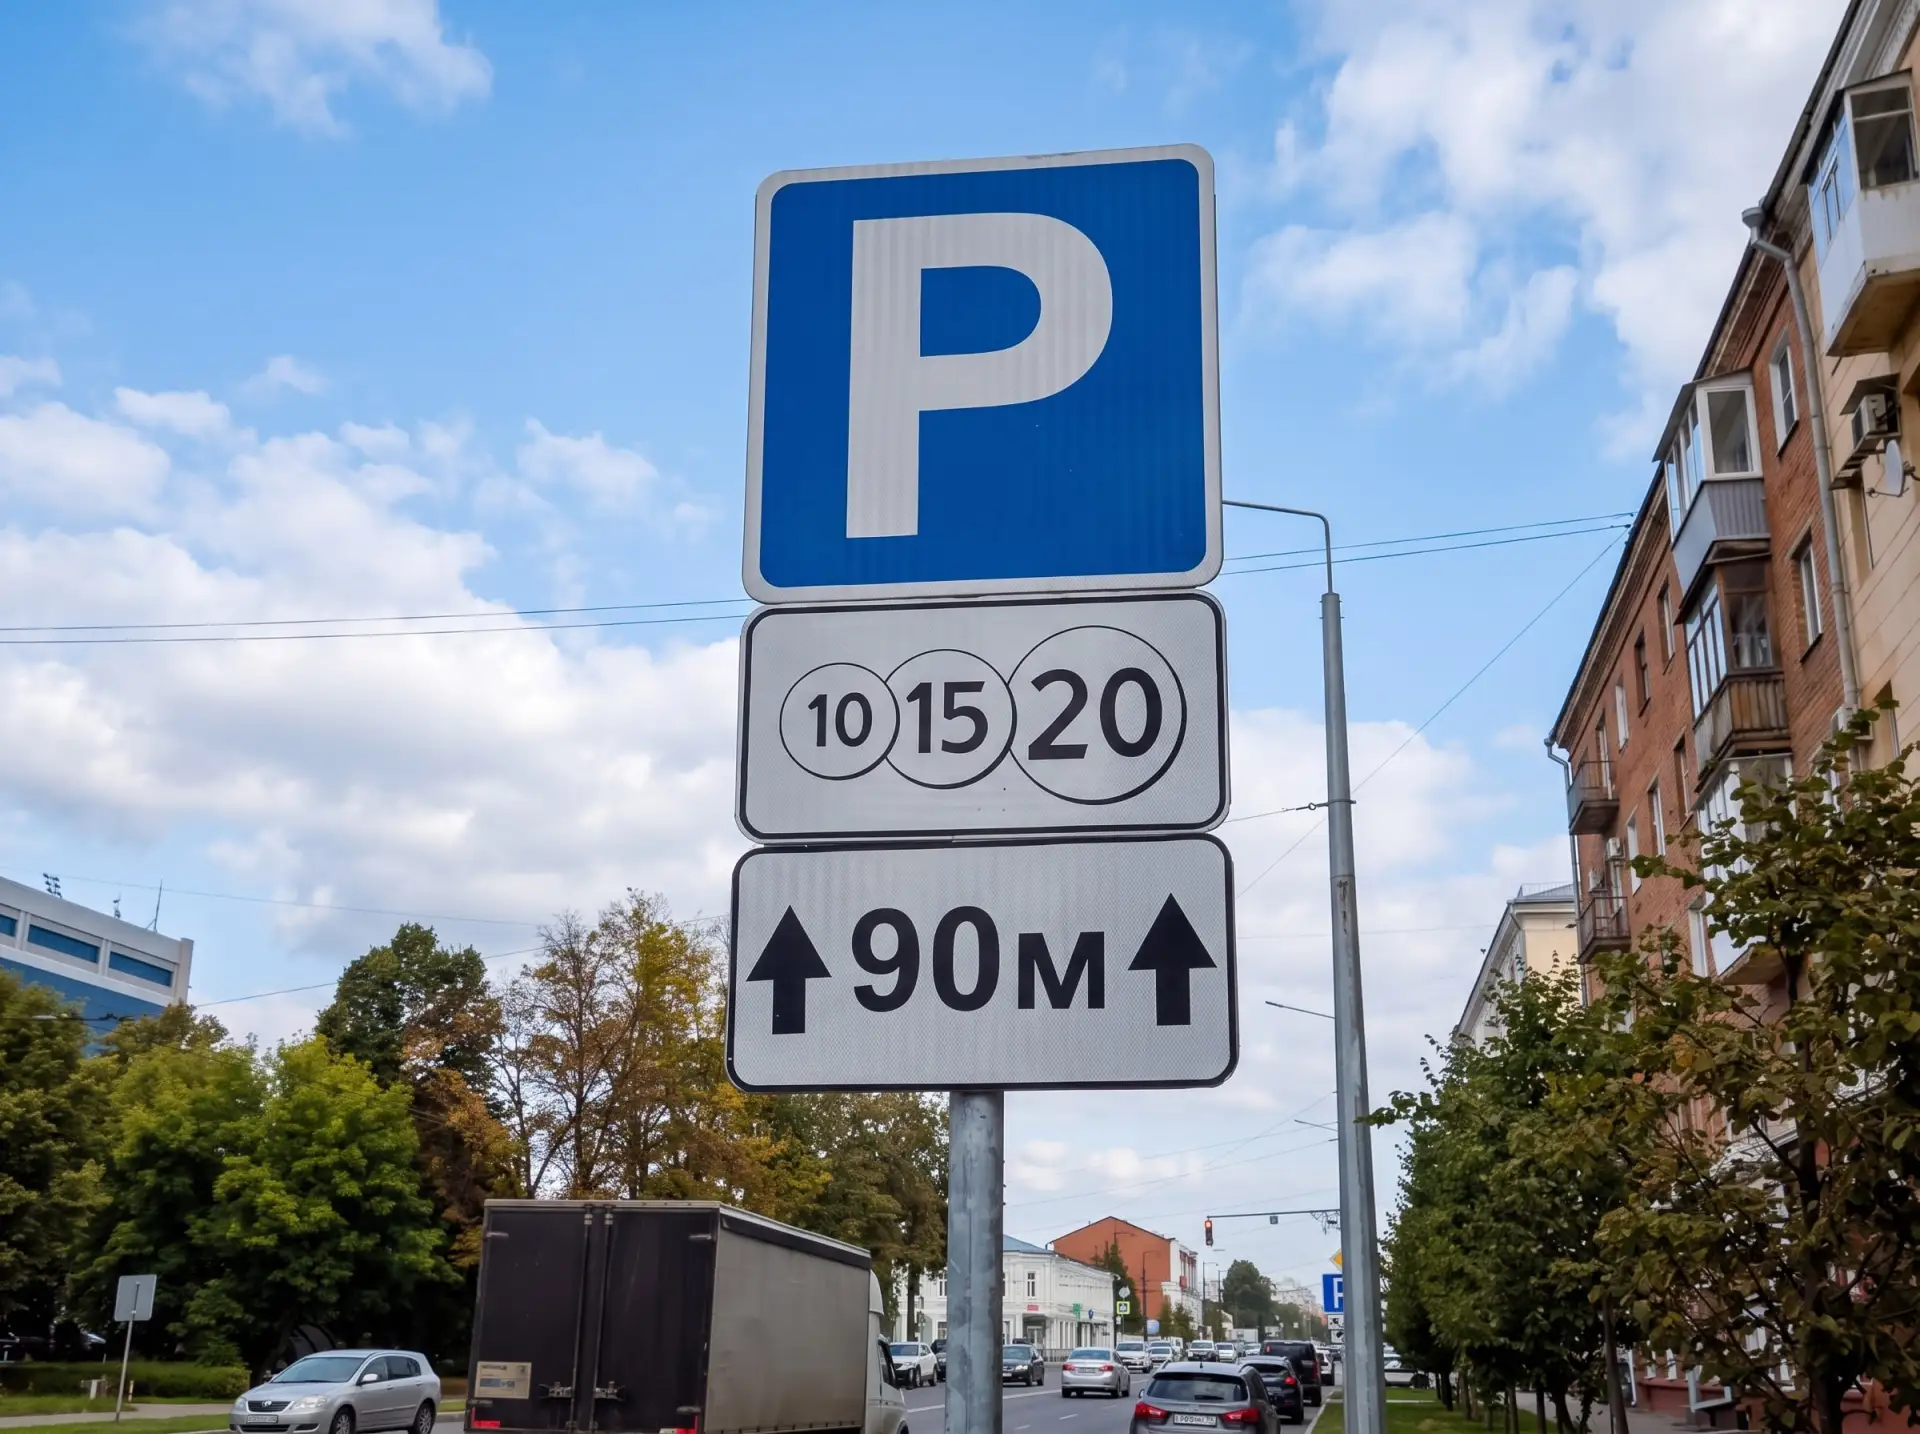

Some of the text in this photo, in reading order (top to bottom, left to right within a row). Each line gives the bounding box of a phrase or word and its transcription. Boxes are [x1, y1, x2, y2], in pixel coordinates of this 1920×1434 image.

[846, 212, 1113, 538] P
[808, 667, 1163, 760] 10 15 20
